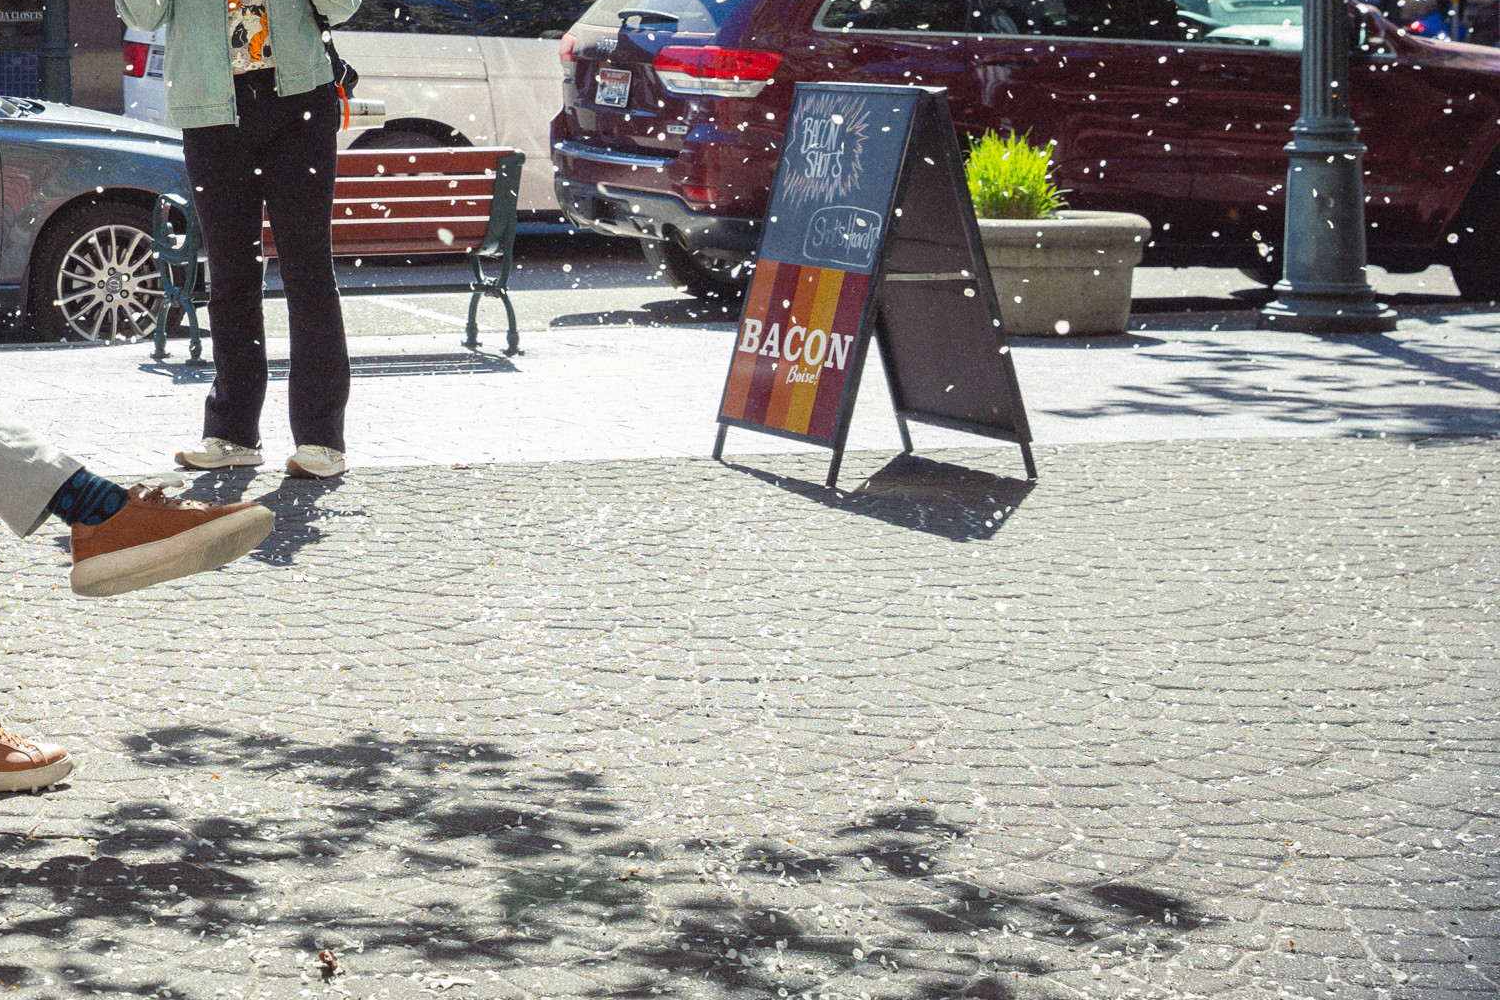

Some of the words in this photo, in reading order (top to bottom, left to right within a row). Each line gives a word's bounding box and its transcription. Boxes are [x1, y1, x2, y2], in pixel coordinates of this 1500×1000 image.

[11, 11, 44, 20] CLOSETS
[801, 116, 841, 154] BACON
[738, 318, 854, 370] BACON
[785, 364, 822, 385] Boise!
